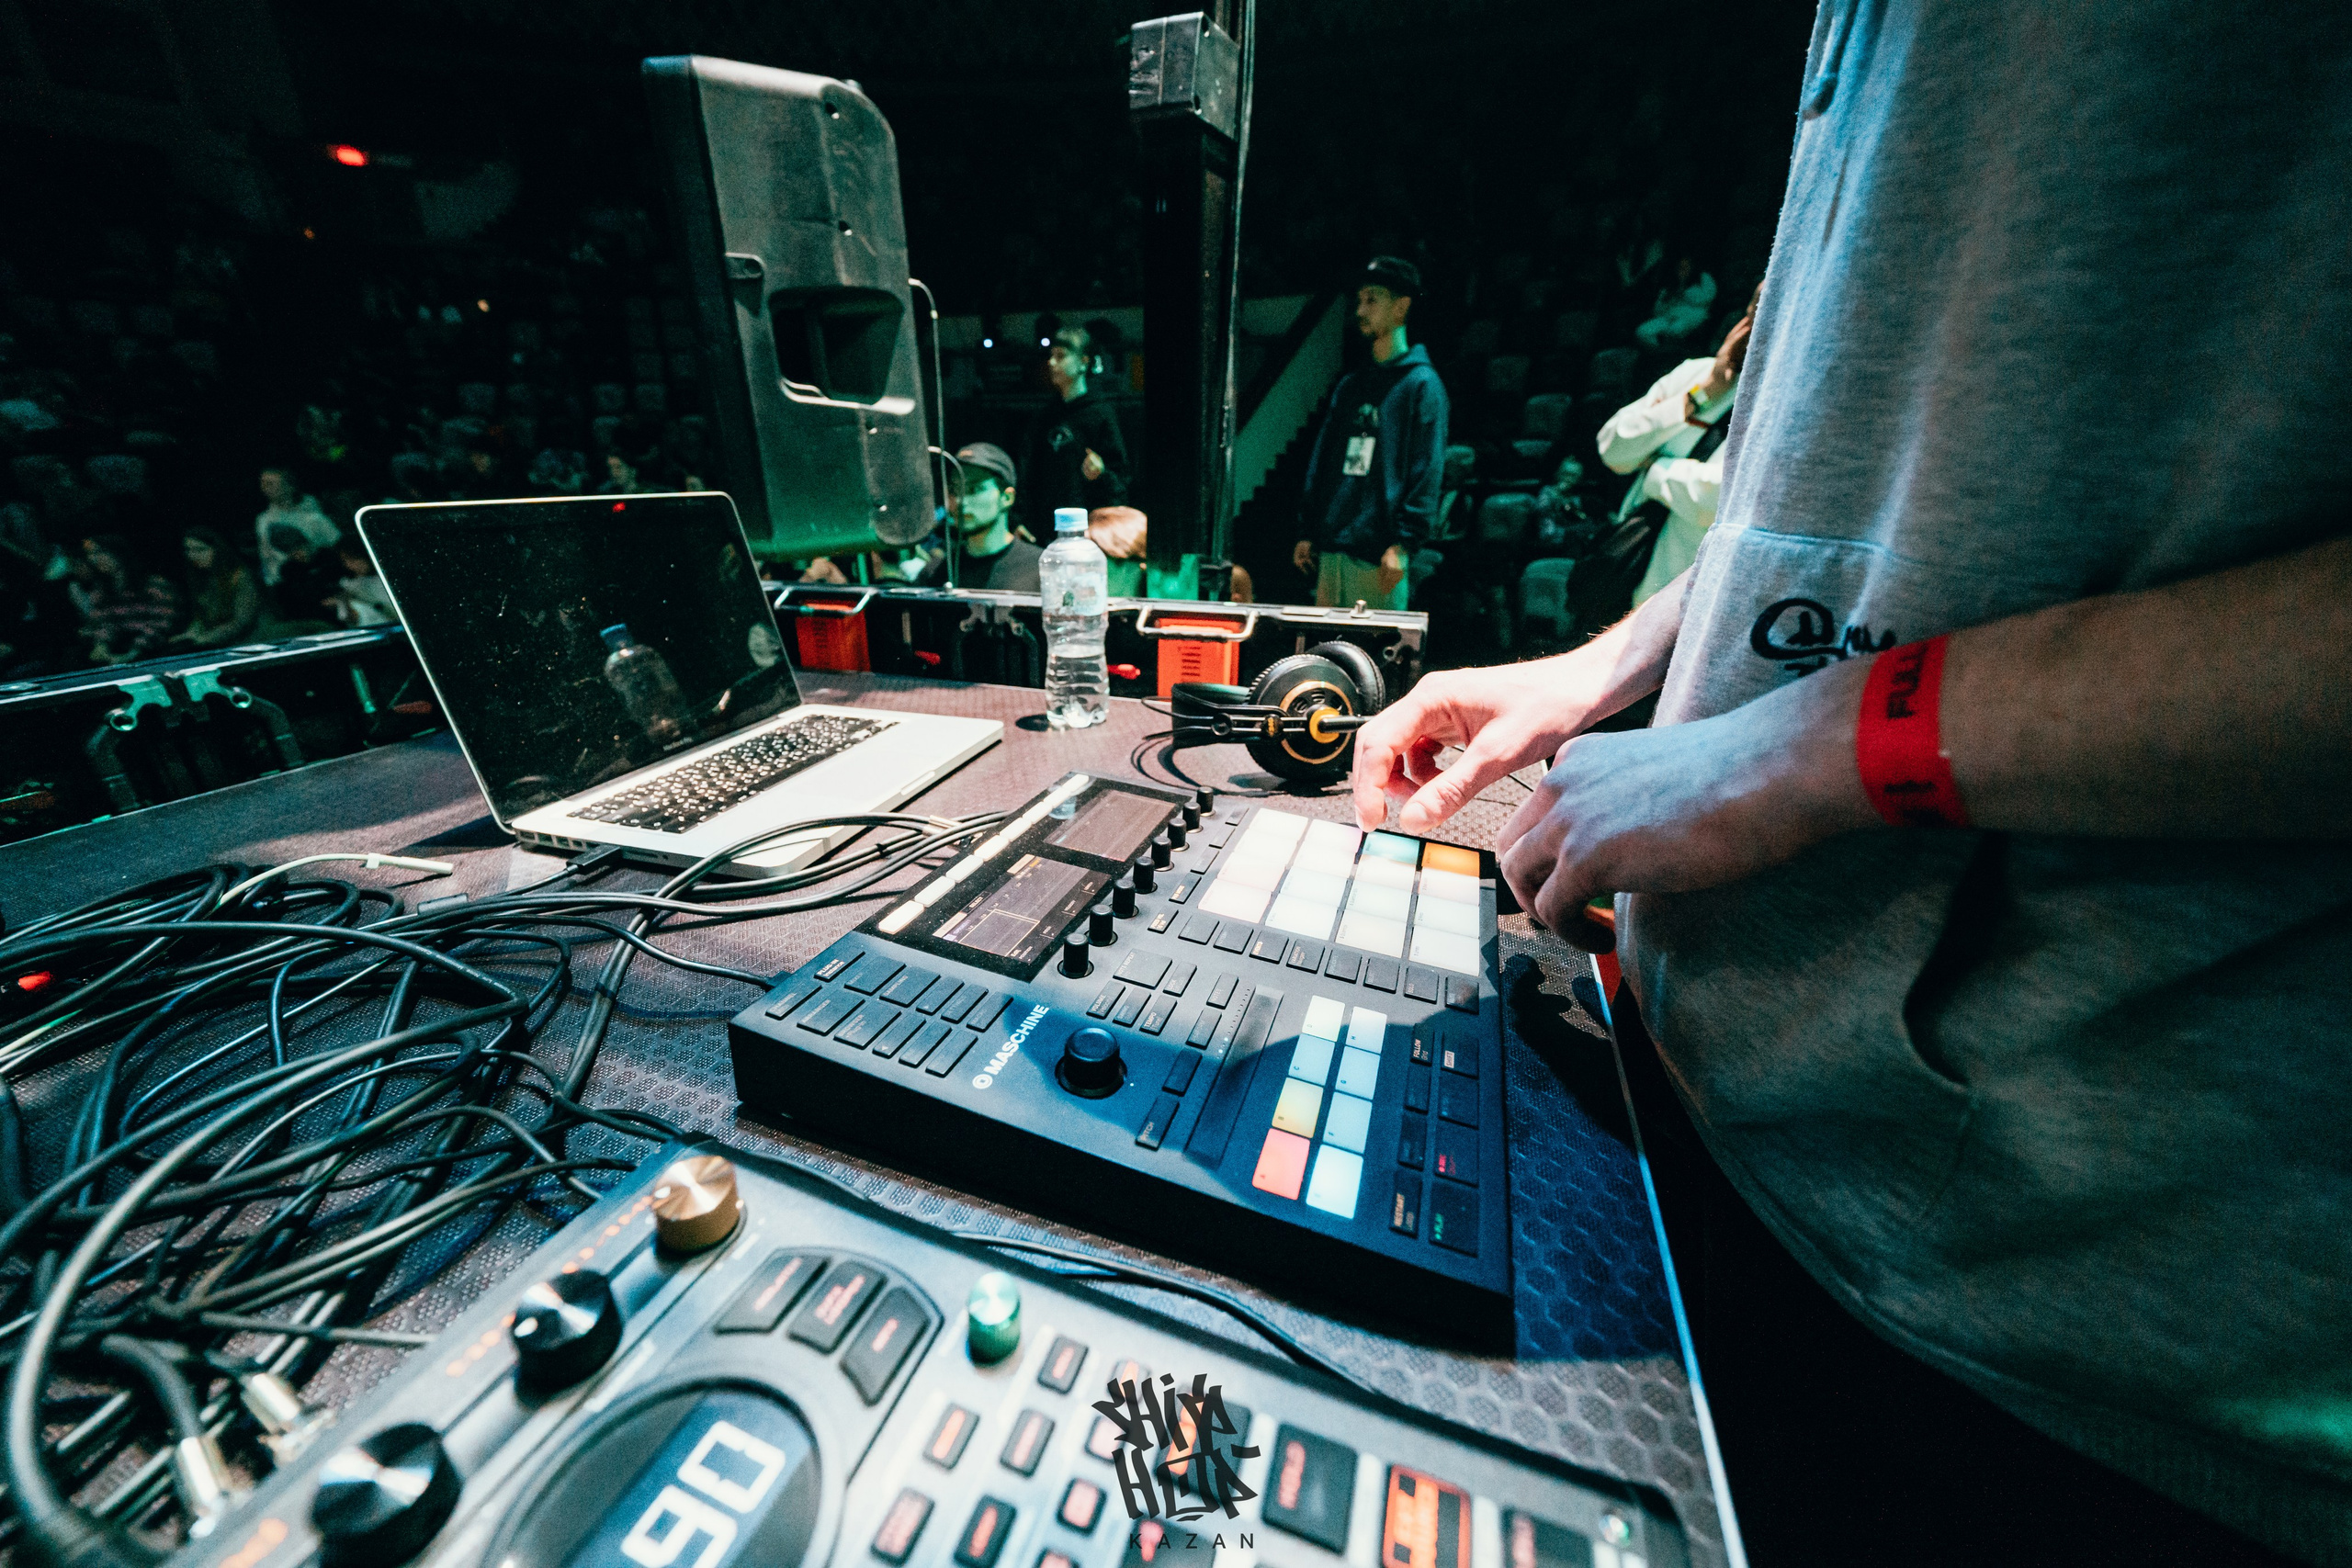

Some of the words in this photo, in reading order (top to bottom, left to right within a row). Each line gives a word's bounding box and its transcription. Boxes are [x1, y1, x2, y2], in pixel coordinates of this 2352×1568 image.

[984, 1003, 1050, 1076] MASCHINE
[1413, 1039, 1422, 1058] FOLLOW
[1444, 1051, 1454, 1067] SHIFT
[620, 1420, 786, 1568] 90
